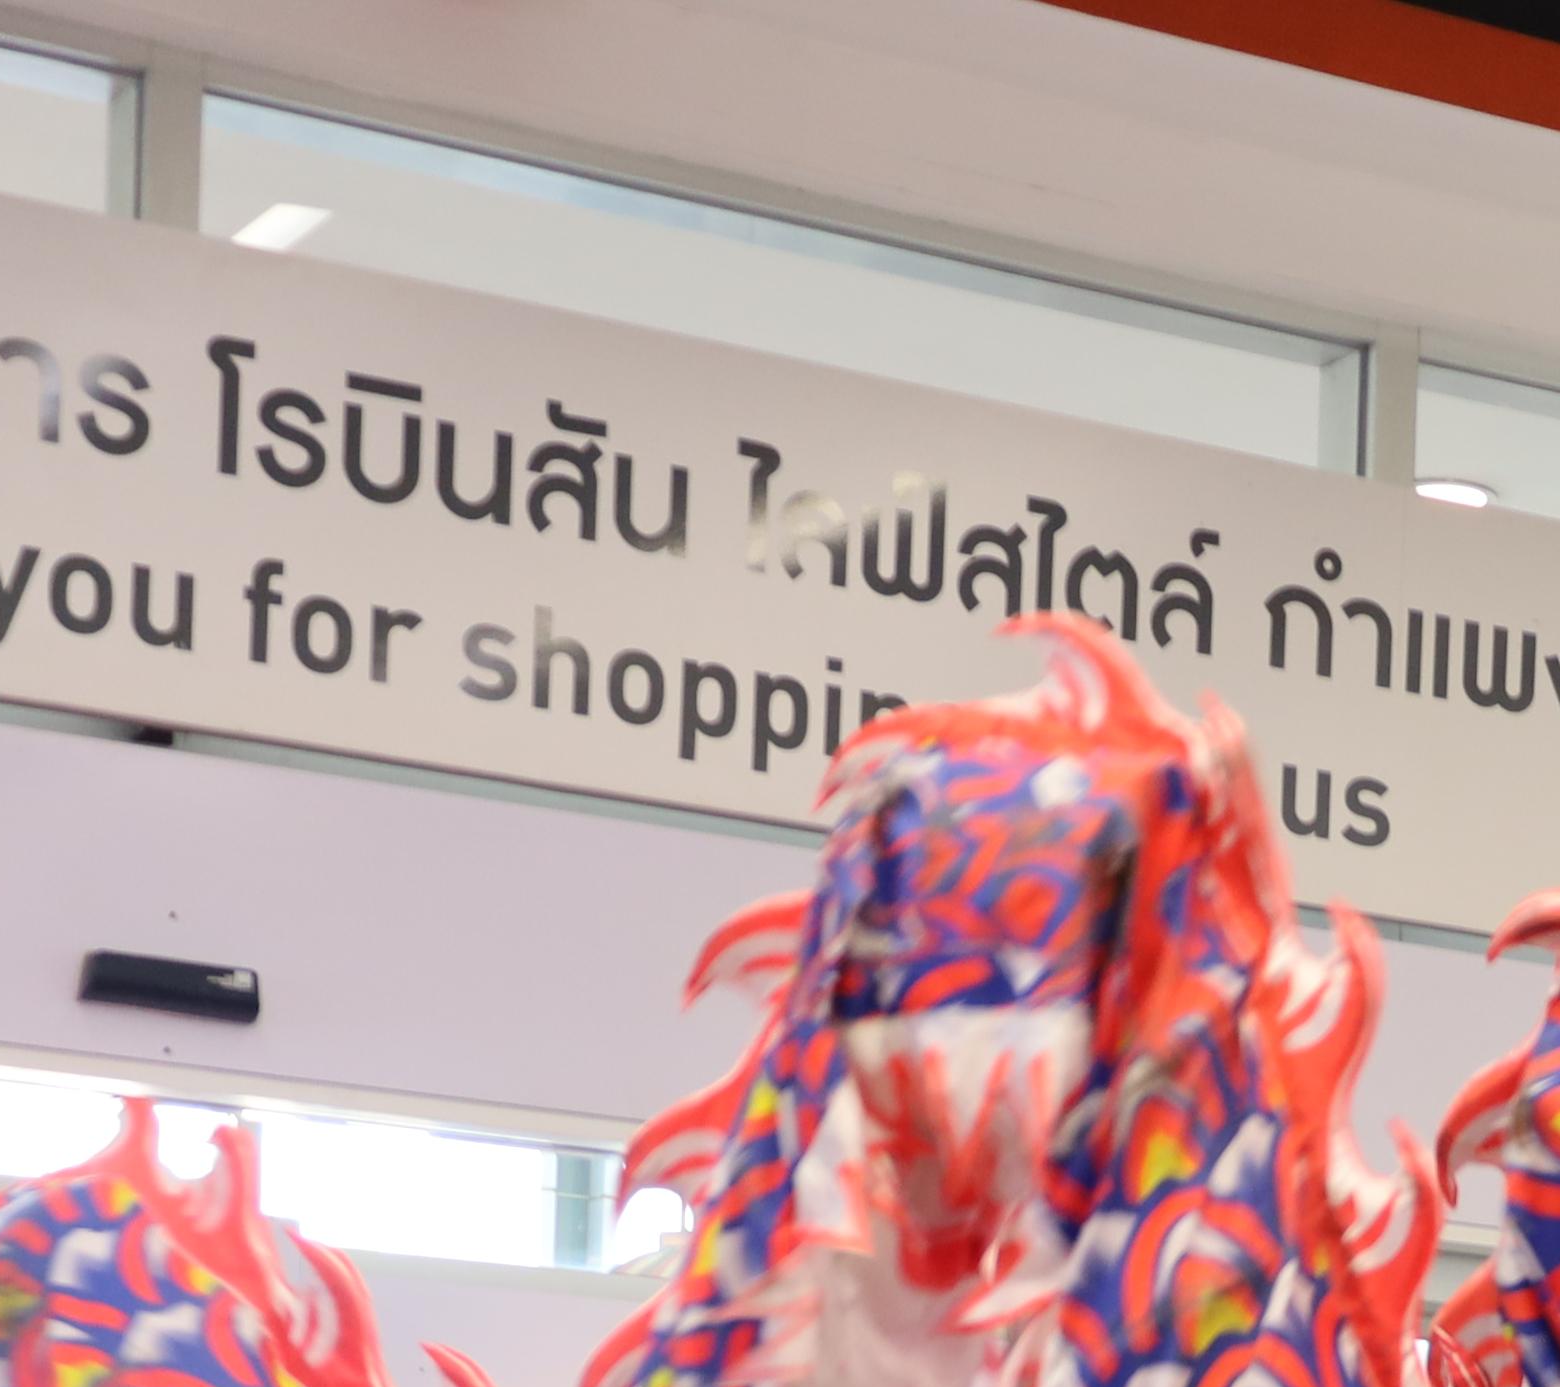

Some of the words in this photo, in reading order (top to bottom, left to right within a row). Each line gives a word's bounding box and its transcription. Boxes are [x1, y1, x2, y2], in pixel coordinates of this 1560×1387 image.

[208, 337, 690, 556] โรบินสัน
[737, 439, 1218, 656] ไลฟ์สไตล์
[246, 560, 421, 685] for
[458, 604, 909, 772] shoppi
[1278, 758, 1389, 845] us
